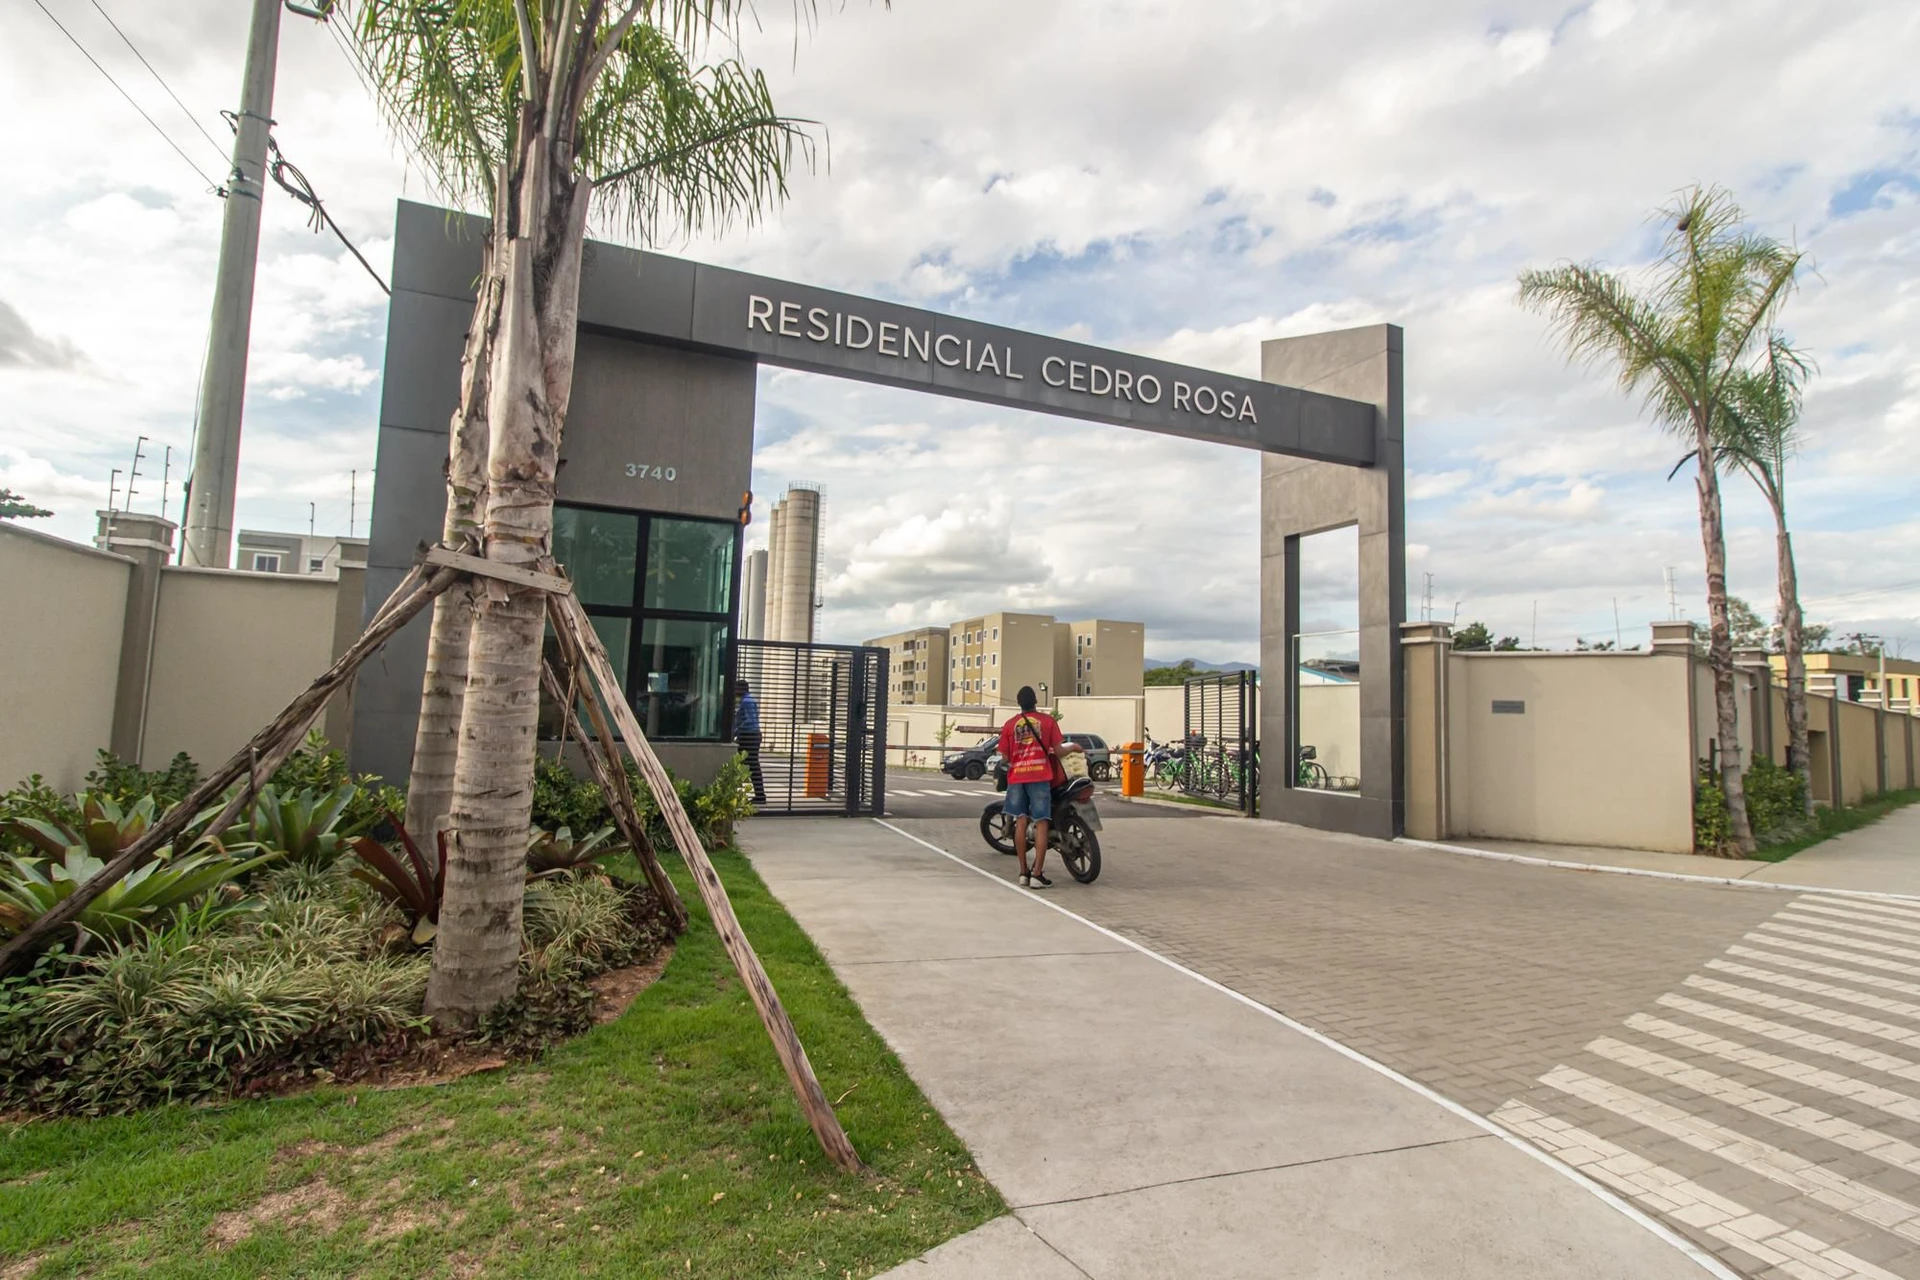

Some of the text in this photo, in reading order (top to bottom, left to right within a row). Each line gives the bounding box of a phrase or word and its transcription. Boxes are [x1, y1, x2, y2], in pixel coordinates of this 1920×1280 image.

[747, 294, 1258, 424] RESIDENCIAL CEDRO ROSA
[625, 463, 677, 481] 3740
